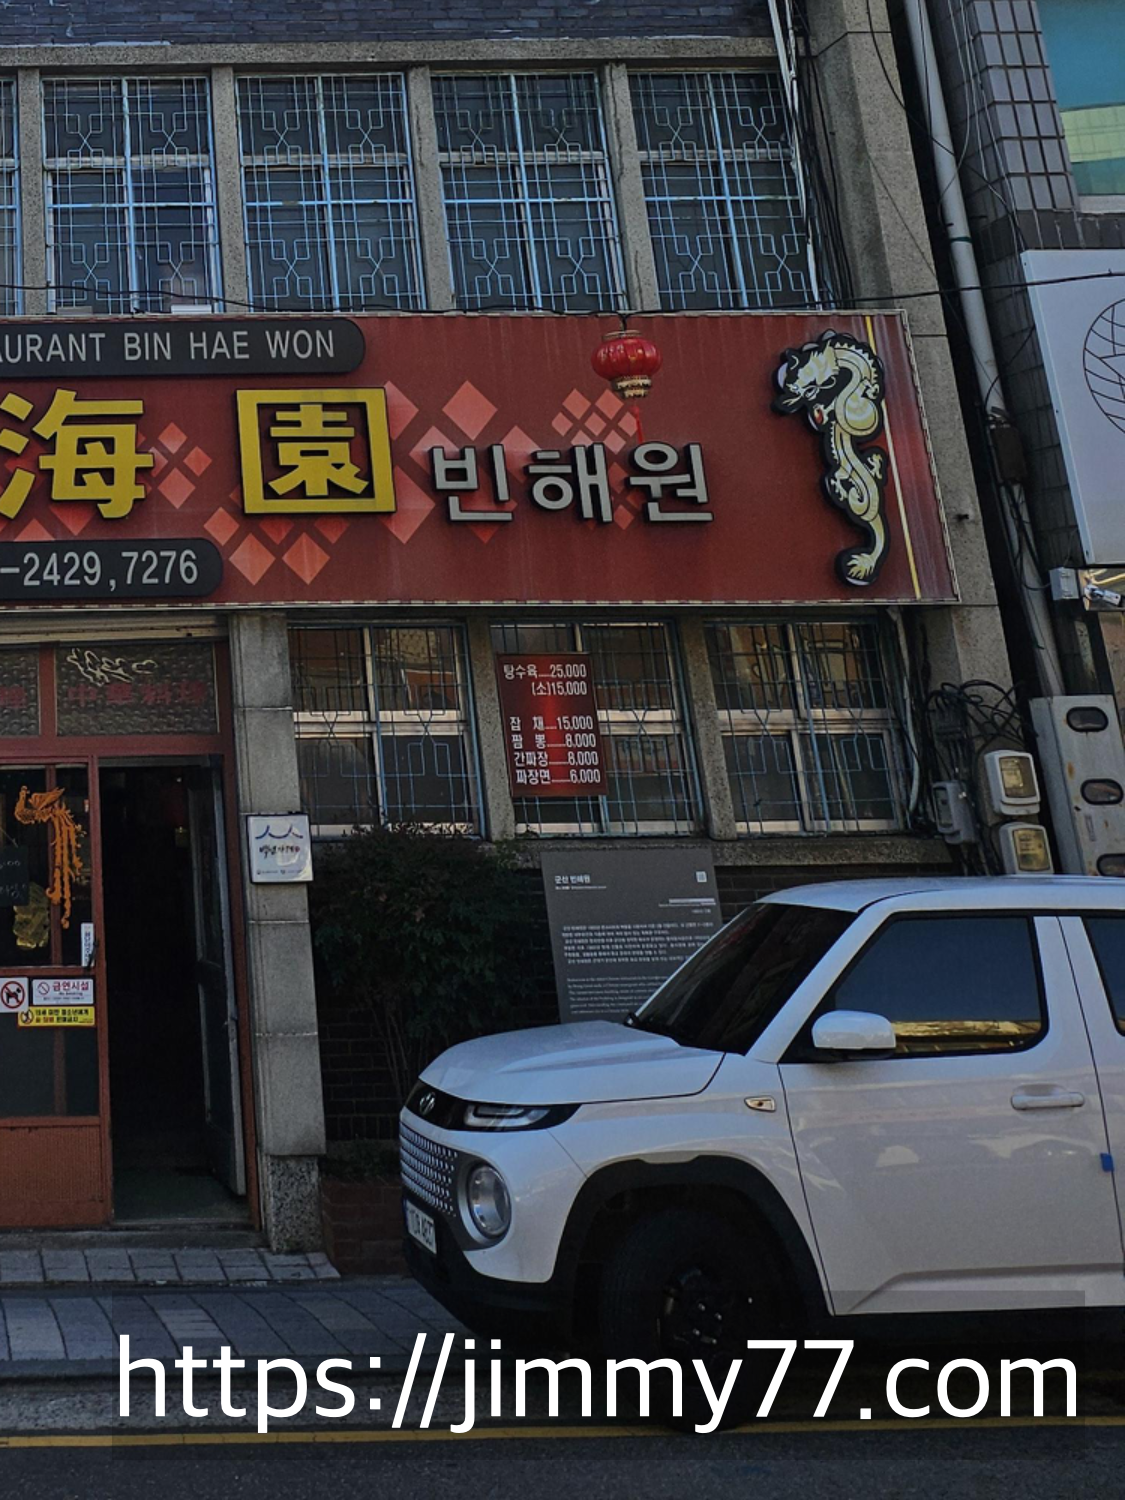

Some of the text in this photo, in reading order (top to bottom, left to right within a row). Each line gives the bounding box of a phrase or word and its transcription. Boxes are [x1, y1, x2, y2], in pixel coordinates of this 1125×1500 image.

[122, 329, 173, 362] BIN
[189, 330, 251, 361] HAE
[266, 328, 336, 360] WON
[429, 440, 714, 523] 빈해원
[503, 663, 587, 680] 탕수육 25,000
[556, 716, 594, 731] 15,000
[565, 733, 597, 749] 8,000
[514, 751, 549, 767] 간짜장
[515, 768, 601, 785] 짜장면 6,000
[52, 980, 89, 992] 금연시설
